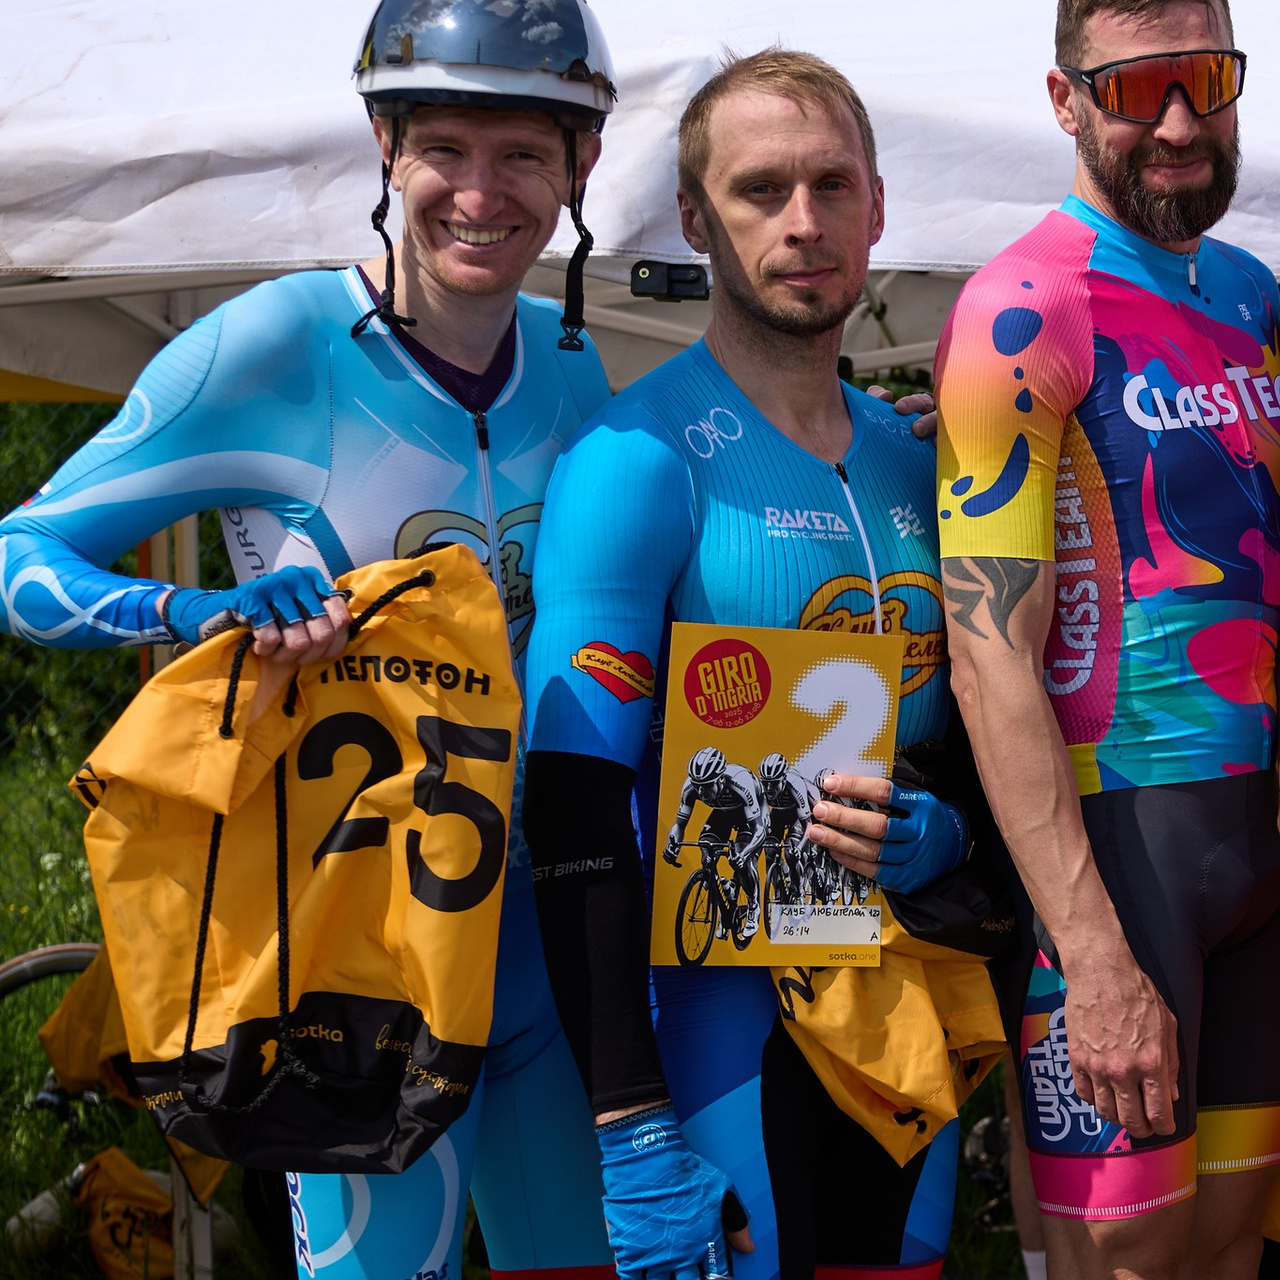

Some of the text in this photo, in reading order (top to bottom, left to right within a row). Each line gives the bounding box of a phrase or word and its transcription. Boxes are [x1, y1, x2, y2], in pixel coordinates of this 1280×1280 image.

[764, 507, 850, 532] RAKETA
[768, 529, 789, 539] PRO
[697, 651, 758, 695] GIRO
[724, 707, 743, 718] 2025
[788, 654, 894, 778] 2
[297, 712, 512, 913] 25
[555, 857, 614, 876] BIKING
[781, 907, 805, 917] КЛУБ
